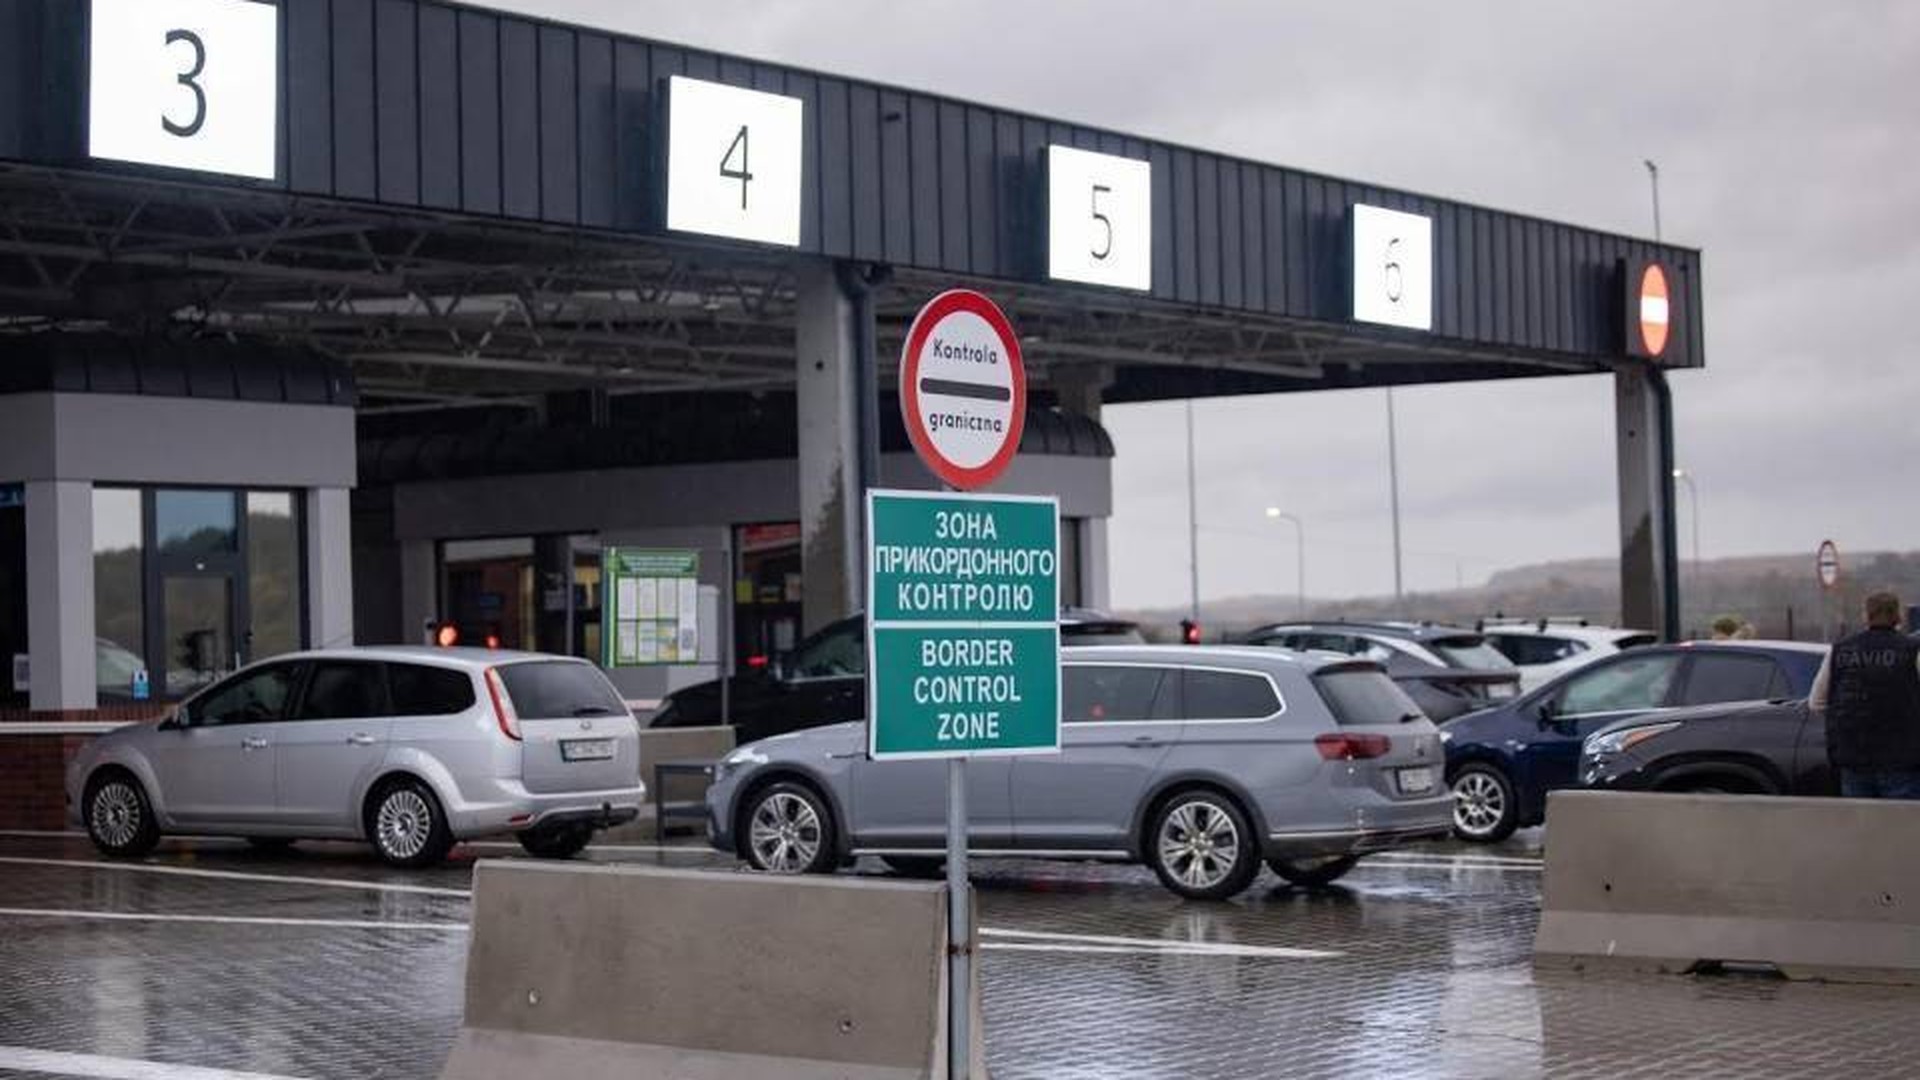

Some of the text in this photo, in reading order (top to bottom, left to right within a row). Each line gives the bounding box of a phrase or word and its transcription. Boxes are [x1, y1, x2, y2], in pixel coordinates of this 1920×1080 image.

[162, 29, 206, 137] 3
[719, 125, 753, 210] 4
[1091, 184, 1112, 260] 5
[1385, 237, 1402, 302] 6
[933, 338, 998, 365] Kontrola
[929, 410, 1003, 434] graniczna
[935, 511, 998, 541] ЗОНА
[875, 545, 1055, 578] ПРИКОРДОННОГО
[898, 582, 1035, 612] КОНТРОЛЮ
[921, 638, 1014, 667] BORDER
[914, 676, 1021, 704] CONTROL
[937, 712, 1000, 741] ZONE
